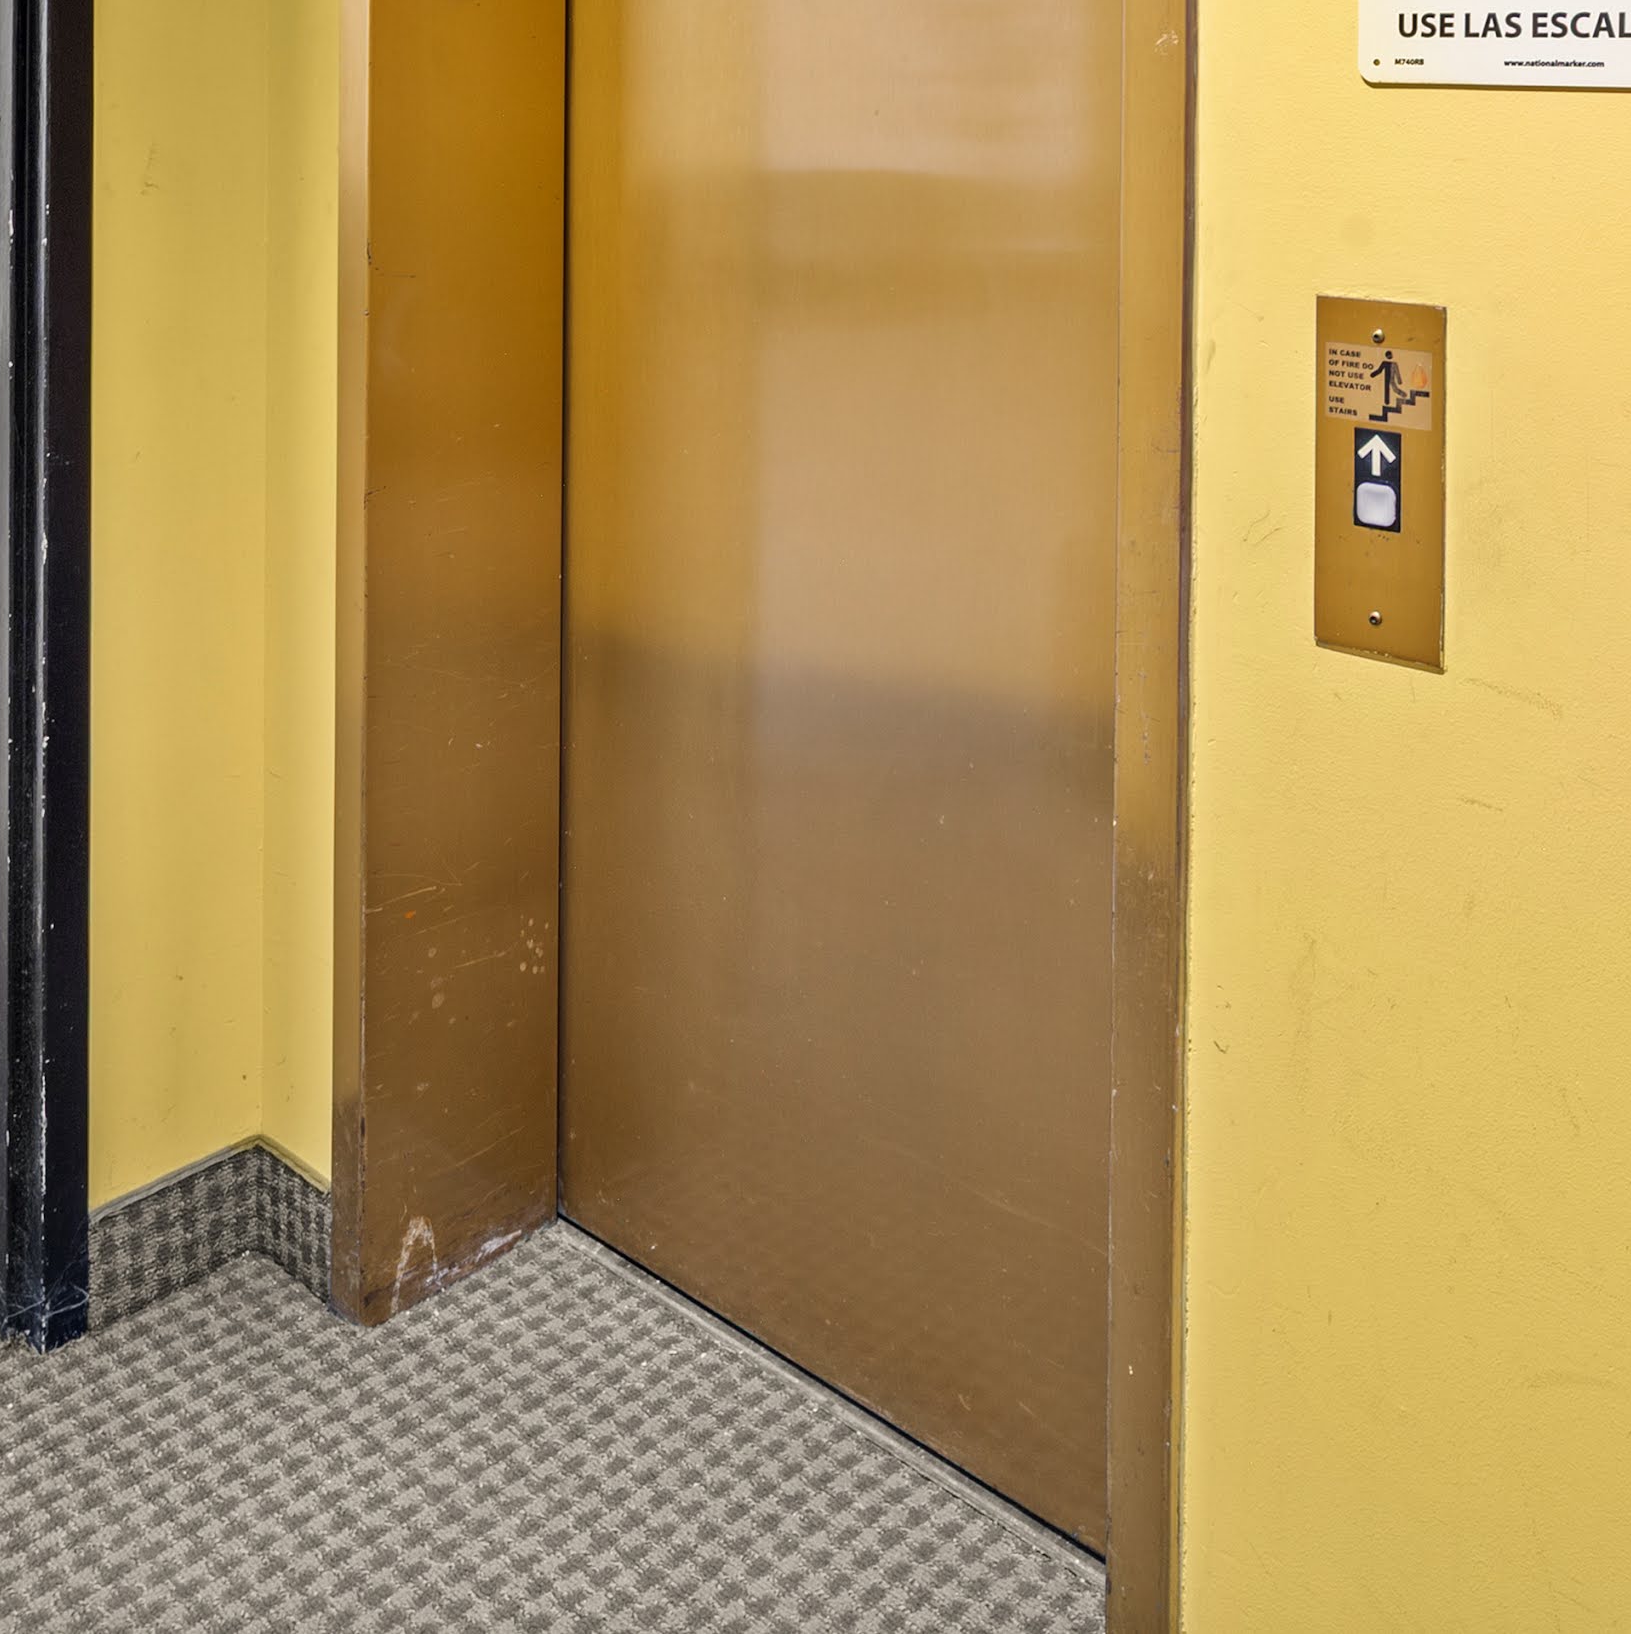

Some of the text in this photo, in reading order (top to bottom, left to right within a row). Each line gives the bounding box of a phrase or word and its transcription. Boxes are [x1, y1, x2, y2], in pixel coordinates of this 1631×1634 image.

[1398, 13, 1455, 39] USE
[1464, 12, 1522, 39] LAS
[1329, 381, 1371, 391] ELEVATOR
[1329, 407, 1357, 415] STAIRS
